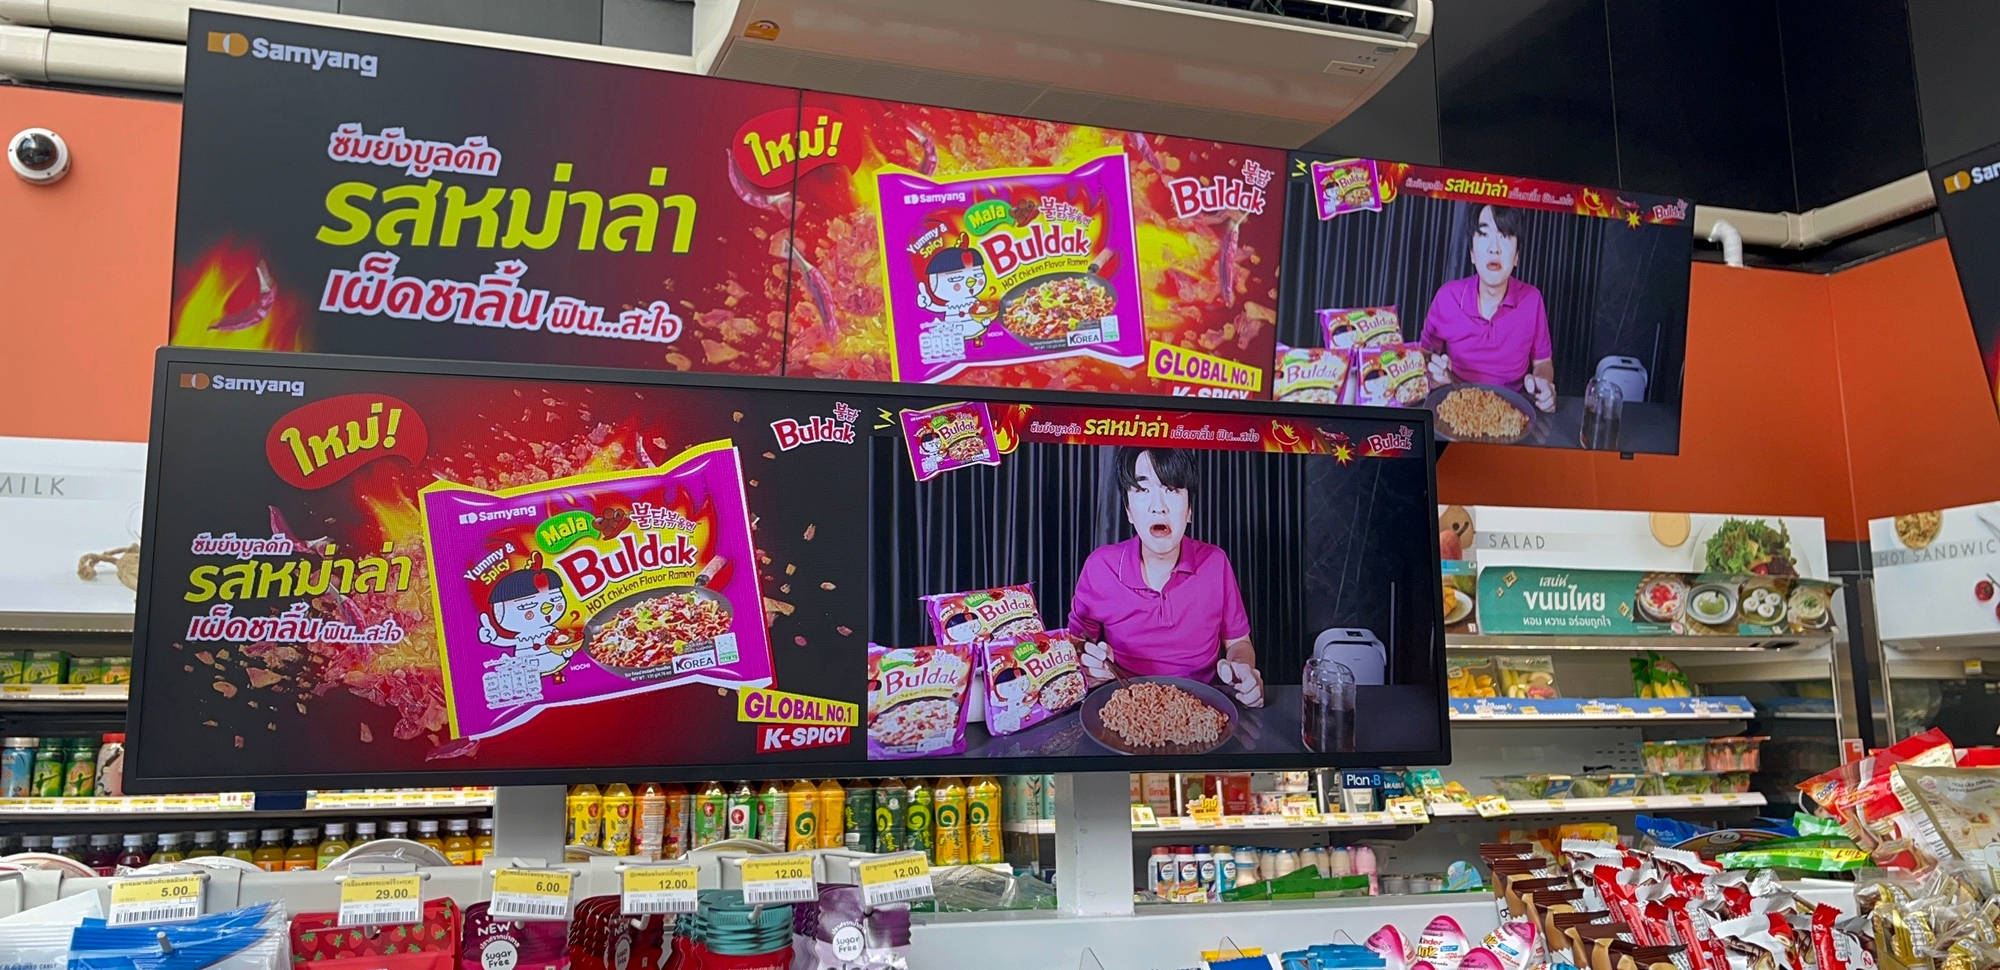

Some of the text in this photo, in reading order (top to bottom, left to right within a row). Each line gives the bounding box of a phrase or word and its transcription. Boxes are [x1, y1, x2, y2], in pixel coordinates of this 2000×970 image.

[252, 37, 378, 77] Samyang
[330, 123, 500, 175] ซัมยังบูลดัก
[743, 114, 844, 177] ใหม่!
[919, 192, 966, 204] Samyang
[1168, 176, 1266, 219] Buldak
[1445, 176, 1508, 198] รสหม่าล่า
[315, 162, 697, 254] รสหม่าล่า
[968, 205, 1006, 230] Mala
[906, 227, 939, 255] Yummy
[919, 237, 944, 259] Spicy
[979, 222, 1091, 278] Buldak
[320, 251, 547, 327] เผ็ดชาลิ้น
[1002, 274, 1018, 290] HOT
[1018, 264, 1044, 280] Chicken
[1356, 316, 1395, 333] Buldak
[1069, 333, 1099, 345] KOREA
[1155, 348, 1255, 387] GLOBAL NO.1
[1286, 364, 1339, 383] Buldak
[1387, 359, 1423, 379] Buldak
[212, 375, 305, 396] Samyang
[770, 416, 856, 452] Buldak
[938, 421, 975, 440] Buldak
[1084, 414, 1169, 438] รสหม่าล่า
[280, 402, 402, 476] ใหม่!
[1367, 432, 1412, 453] Buldak
[478, 506, 537, 521] Samyang
[540, 517, 589, 547] Mala
[1489, 533, 1545, 550] SALAD
[193, 534, 293, 559] ซัมยังบูลดัก
[1880, 552, 1906, 565] HOT
[184, 541, 412, 602] รสหม่าล่า
[463, 542, 515, 582] Yummy &
[480, 559, 511, 586] Spicy
[556, 532, 697, 600] Buldak
[586, 571, 695, 615] HOT Chicken Flavor Ramen
[1523, 584, 1606, 611] ขนมไทย
[186, 603, 320, 641] เผ็ดชาลิ้น
[976, 598, 1031, 623] Buldak
[1523, 616, 1543, 626] หอม
[1544, 616, 1566, 626] หวาน
[676, 657, 714, 672] KOREA
[1025, 651, 1075, 679] Buldak
[886, 667, 958, 696] Buldak
[744, 691, 852, 723] GLOBAL NO.1
[763, 726, 848, 750] K-SPICY
[775, 868, 803, 879] 12.00
[893, 865, 920, 879] 12.00
[161, 886, 189, 897] 5.00
[375, 889, 408, 900] 29.00
[536, 882, 560, 893] 6.00
[658, 879, 688, 890] 12.00
[477, 921, 511, 936] NEW
[1419, 936, 1443, 945] Kinder
[836, 936, 860, 946] Sugar
[838, 945, 857, 953] Free
[485, 950, 512, 961] Sugar
[488, 959, 510, 968] Free
